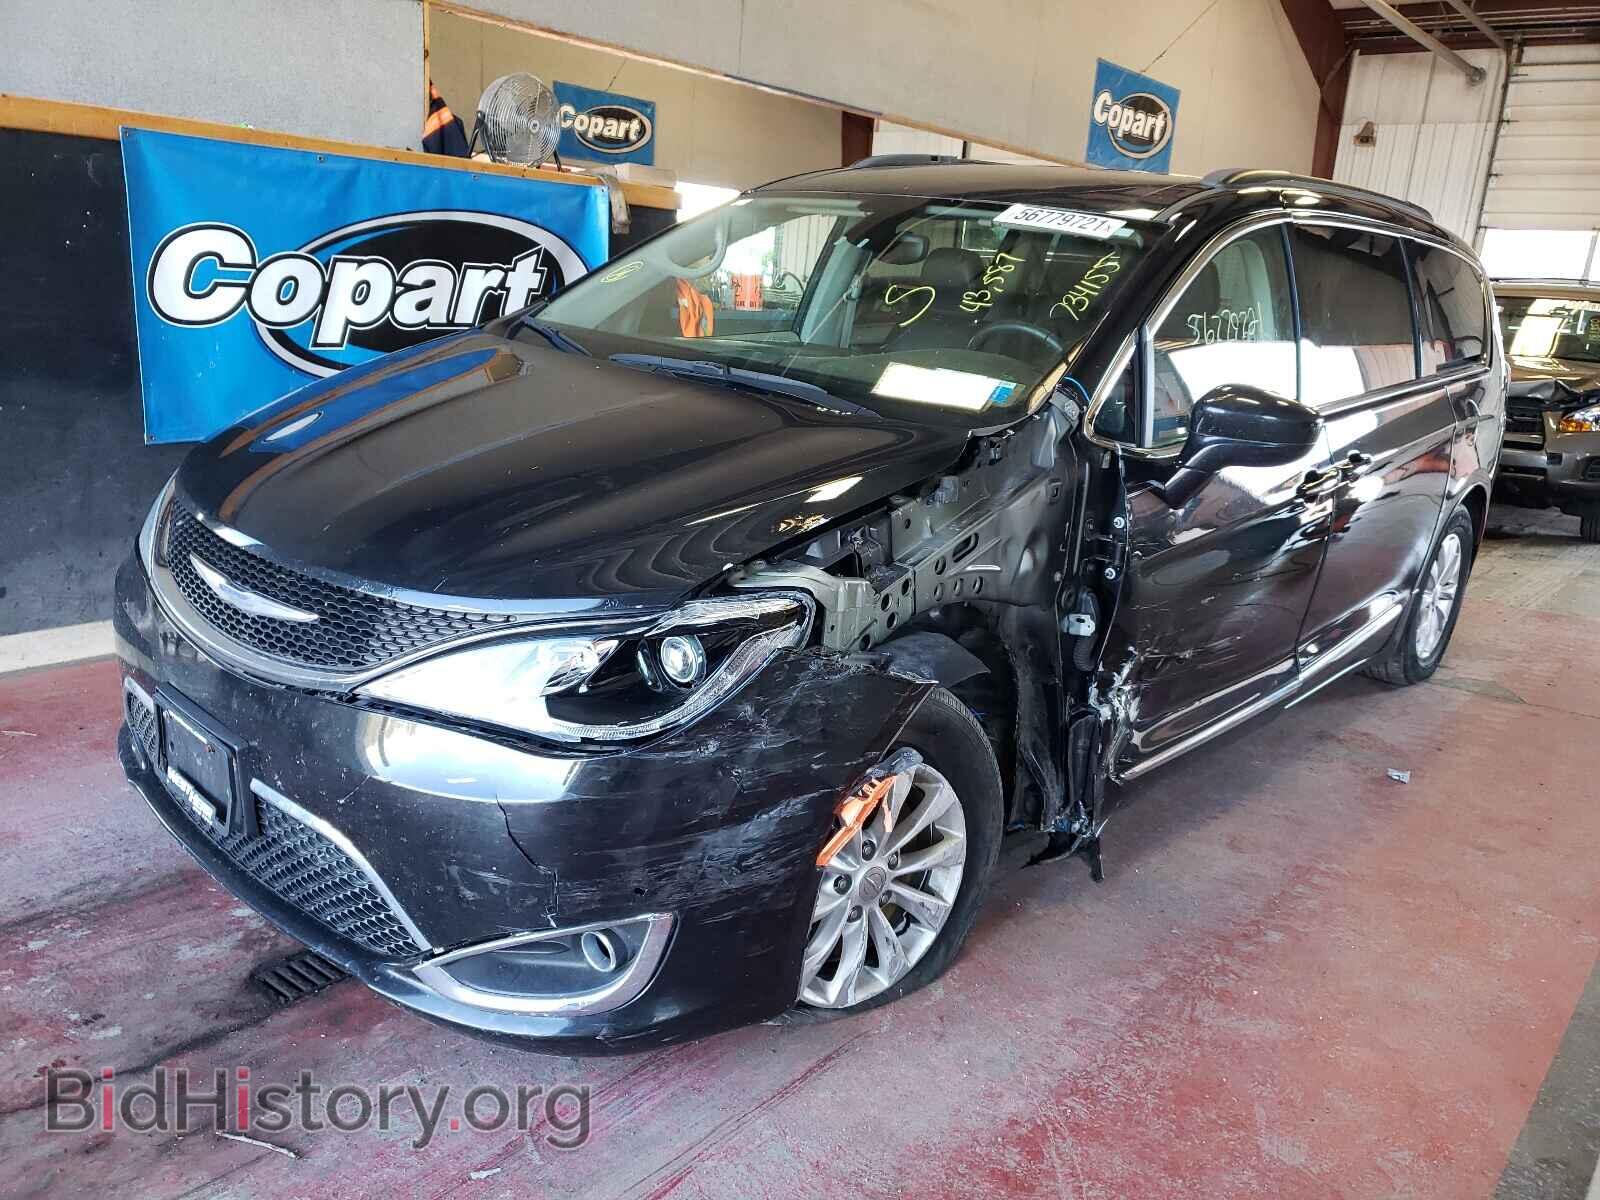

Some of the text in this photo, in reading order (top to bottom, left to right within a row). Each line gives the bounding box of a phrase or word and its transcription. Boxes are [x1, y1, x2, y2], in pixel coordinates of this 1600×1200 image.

[558, 104, 641, 140] Copart
[1093, 90, 1167, 143] Copart
[1014, 208, 1106, 236] 56779721
[147, 222, 546, 349] Copart
